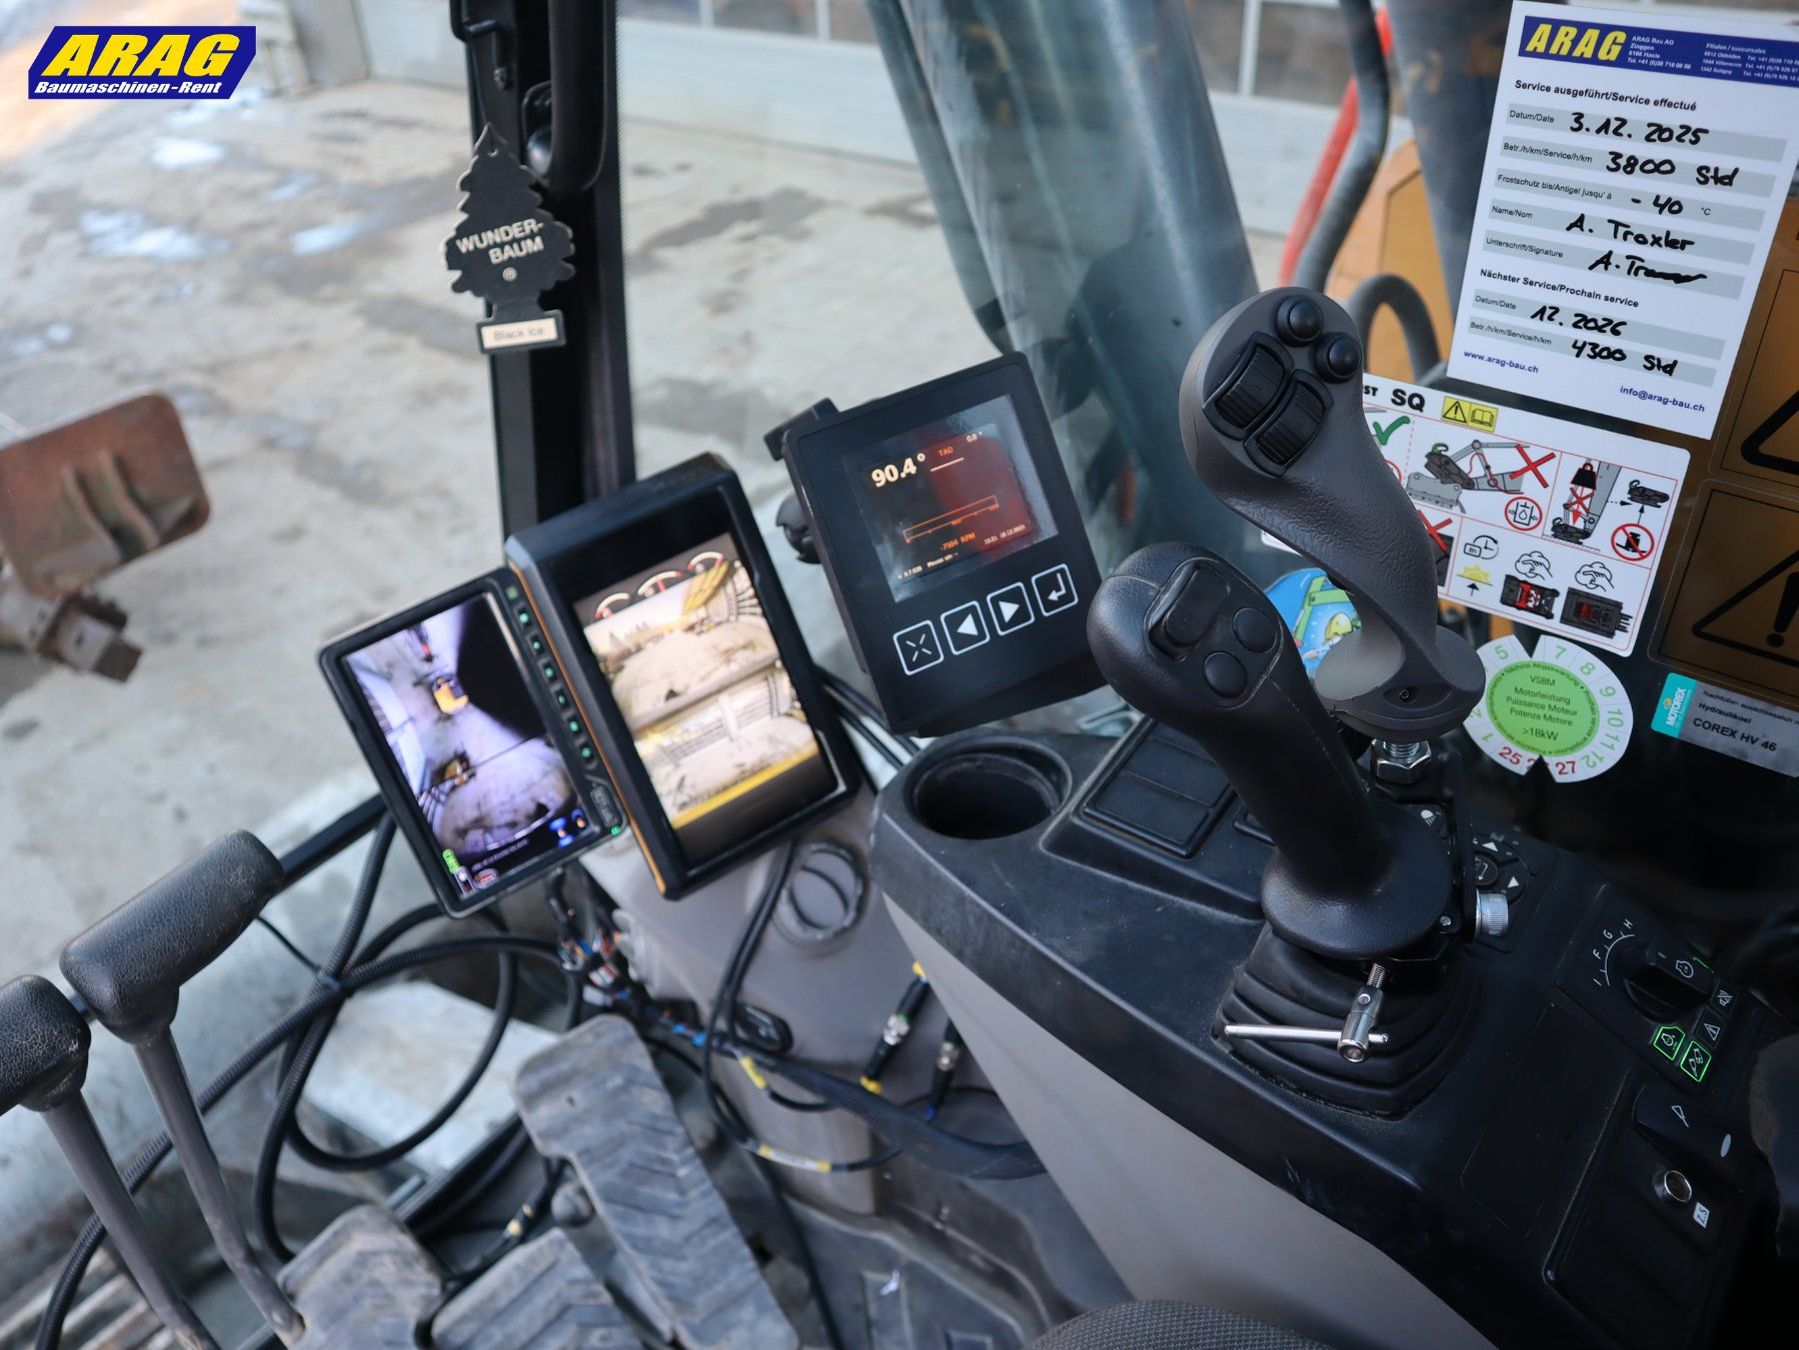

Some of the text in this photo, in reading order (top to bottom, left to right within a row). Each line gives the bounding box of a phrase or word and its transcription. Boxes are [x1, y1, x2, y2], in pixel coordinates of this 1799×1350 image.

[1525, 23, 1627, 61] ARAG
[1515, 79, 1697, 112] Service ausgeführt/Service effectué
[1509, 110, 1555, 124] Datum/Date
[1644, 121, 1710, 146] 2025
[1503, 142, 1593, 164] Betr./h/km/Service/h/km
[1606, 150, 1740, 187] 3800 Std
[1498, 174, 1540, 189] Frostschutz
[1541, 180, 1581, 196] bis/Antigel
[1491, 205, 1533, 220] Name/Nom
[1652, 194, 1684, 216] 40
[1565, 213, 1594, 234] A.
[455, 218, 545, 254] WUNDER-
[488, 235, 545, 265] BAUM
[1486, 237, 1564, 259] Unterschrift/Signature
[1480, 268, 1640, 309] Nächster Service/Prochain service
[1475, 295, 1517, 311] Datum/Date
[493, 326, 545, 341] Black Ice
[1470, 321, 1552, 346] Betr./h/km/Service/h/km
[1571, 311, 1628, 337] 2026
[1463, 350, 1540, 375] www.arag-bau.ch
[1571, 338, 1680, 377] 4300 Std
[1390, 388, 1426, 413] SQ
[1619, 385, 1706, 413] info@arag-bau.ch
[871, 453, 926, 488] 90.4°
[1494, 645, 1509, 660] 5
[1555, 645, 1567, 660] 7
[1580, 662, 1596, 676] 8
[1514, 686, 1571, 705] Motorleistung
[1600, 686, 1616, 698] 9
[1506, 696, 1578, 717] Puissance Moteur
[1510, 708, 1573, 727] Potenza Motore
[1665, 687, 1687, 727] MOTOREX
[1698, 702, 1751, 725] Hydraulikoel
[1607, 708, 1624, 728] 10
[1693, 718, 1777, 752] COREX HV 46
[1498, 746, 1522, 765] 25
[1581, 751, 1604, 769] 12
[1555, 760, 1577, 775] 27
[1603, 929, 1613, 939] G
[1623, 918, 1633, 929] H
[1592, 948, 1601, 960] F
